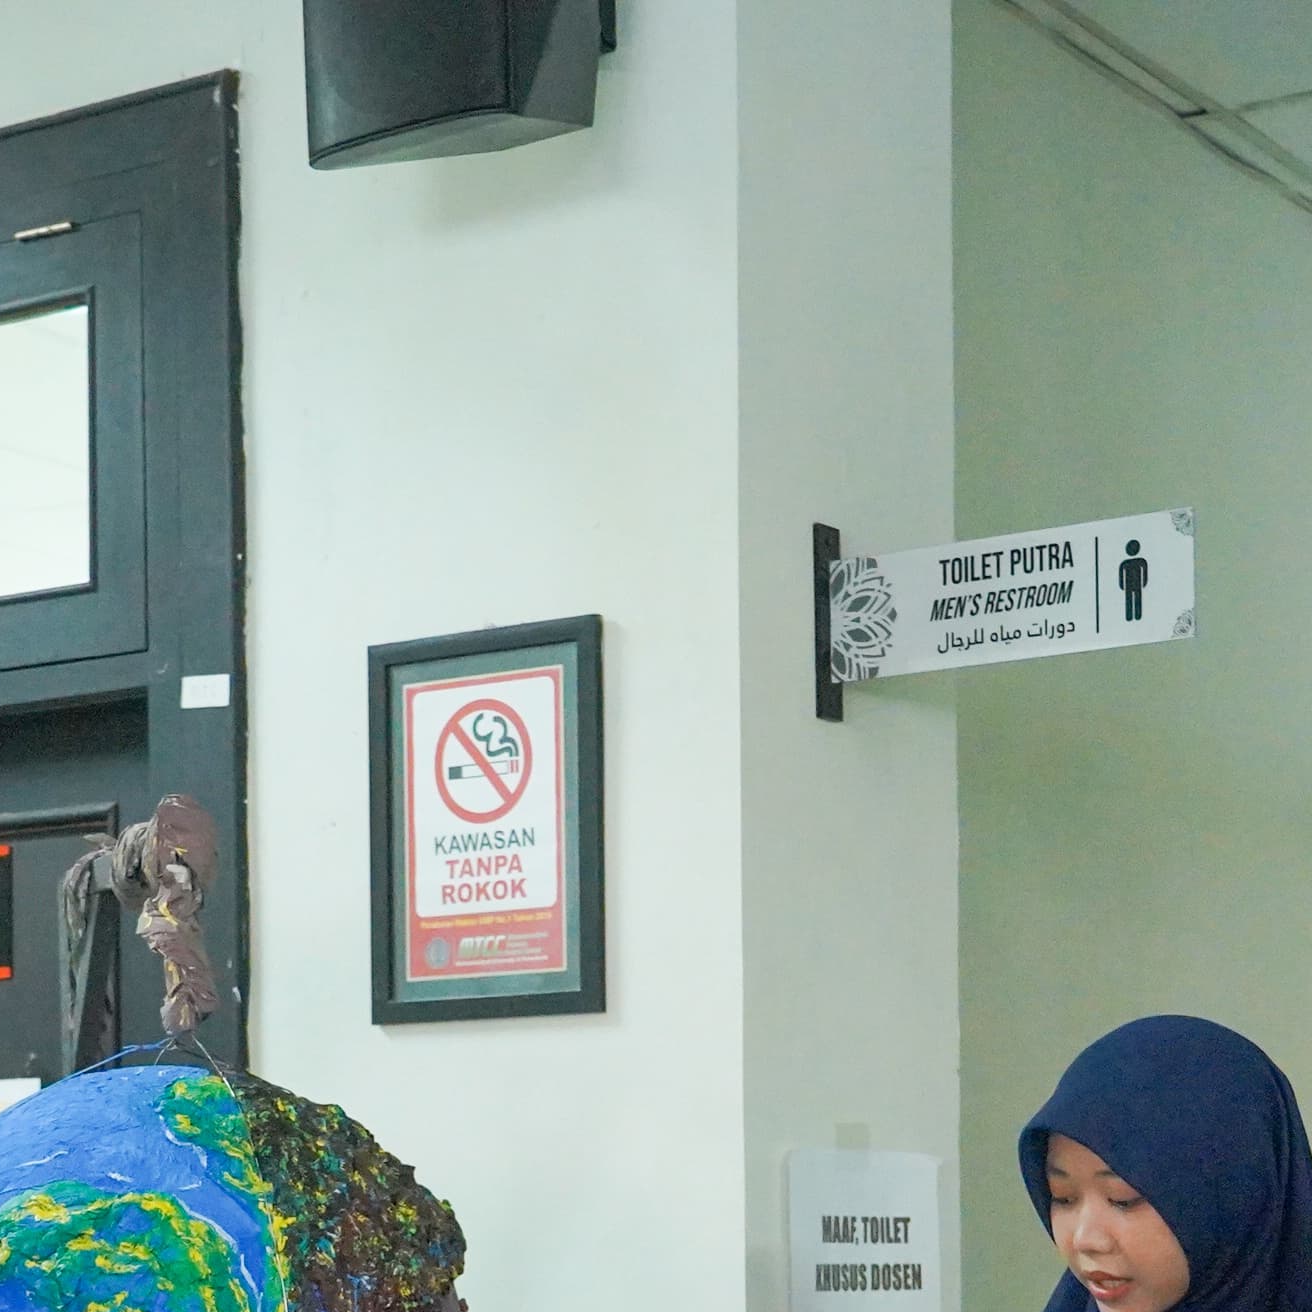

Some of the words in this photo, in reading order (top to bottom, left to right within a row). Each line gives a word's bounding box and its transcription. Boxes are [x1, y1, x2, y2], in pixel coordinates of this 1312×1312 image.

[939, 551, 1004, 586] TOILET
[1010, 541, 1074, 576] PUTRA
[930, 595, 981, 622] MEN'S
[984, 581, 1074, 615] RESTROOM
[937, 628, 985, 654] للرجال
[990, 627, 1023, 645] مياه
[1027, 618, 1075, 641] دورات
[434, 827, 535, 856] KAWASAN
[445, 854, 523, 880] TANPA
[441, 878, 526, 905] ROKOK
[822, 1215, 859, 1245] MAAF,
[861, 1217, 911, 1243] TOILET
[816, 1264, 867, 1291] KHUSUS
[871, 1264, 923, 1290] DOSEN
